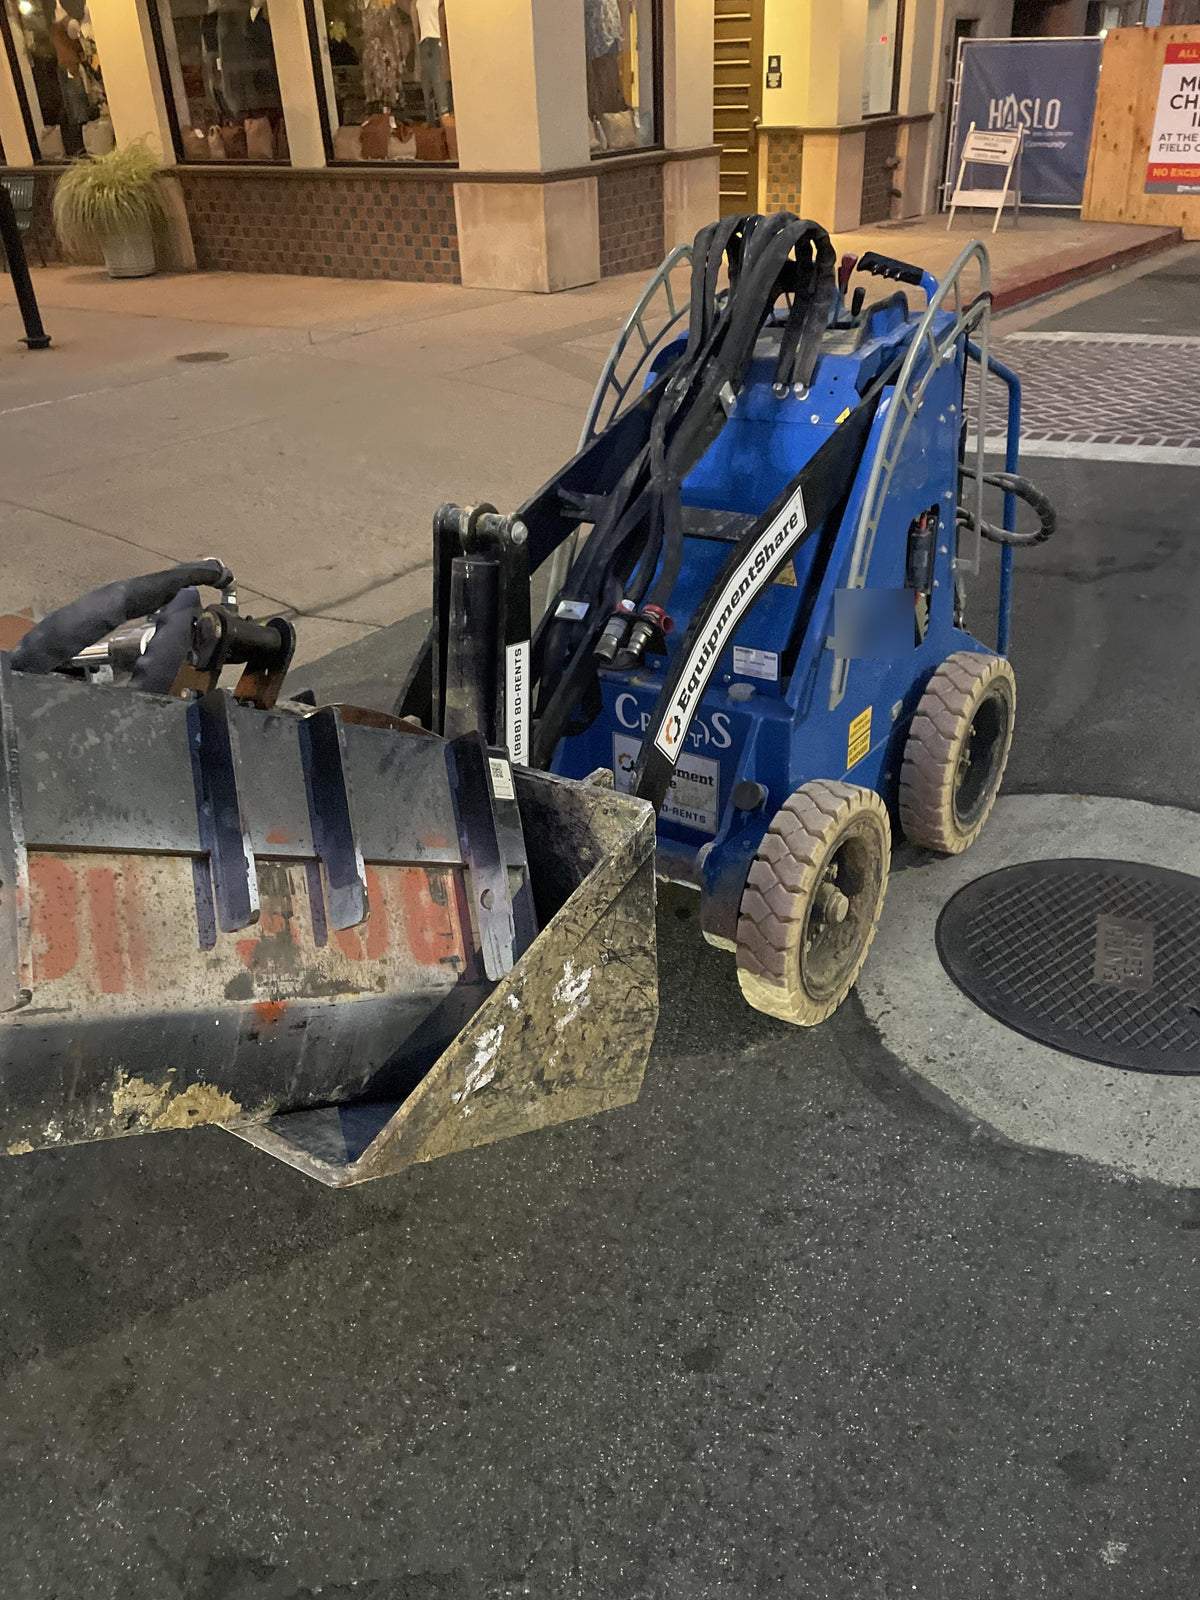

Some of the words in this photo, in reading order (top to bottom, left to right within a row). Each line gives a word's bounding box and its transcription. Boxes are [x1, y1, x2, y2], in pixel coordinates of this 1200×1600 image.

[1177, 49, 1199, 59] ALL
[1180, 76, 1200, 92] M
[988, 92, 1062, 130] HASLO
[1159, 133, 1174, 142] AT
[1177, 133, 1199, 142] THE
[1159, 143, 1192, 152] FIELD
[1152, 167, 1169, 177] NO
[676, 511, 799, 714] EquipmentShare
[514, 647, 522, 716] 80-RENTS
[514, 719, 522, 757] (888)
[662, 804, 706, 824] 0-RENTS
